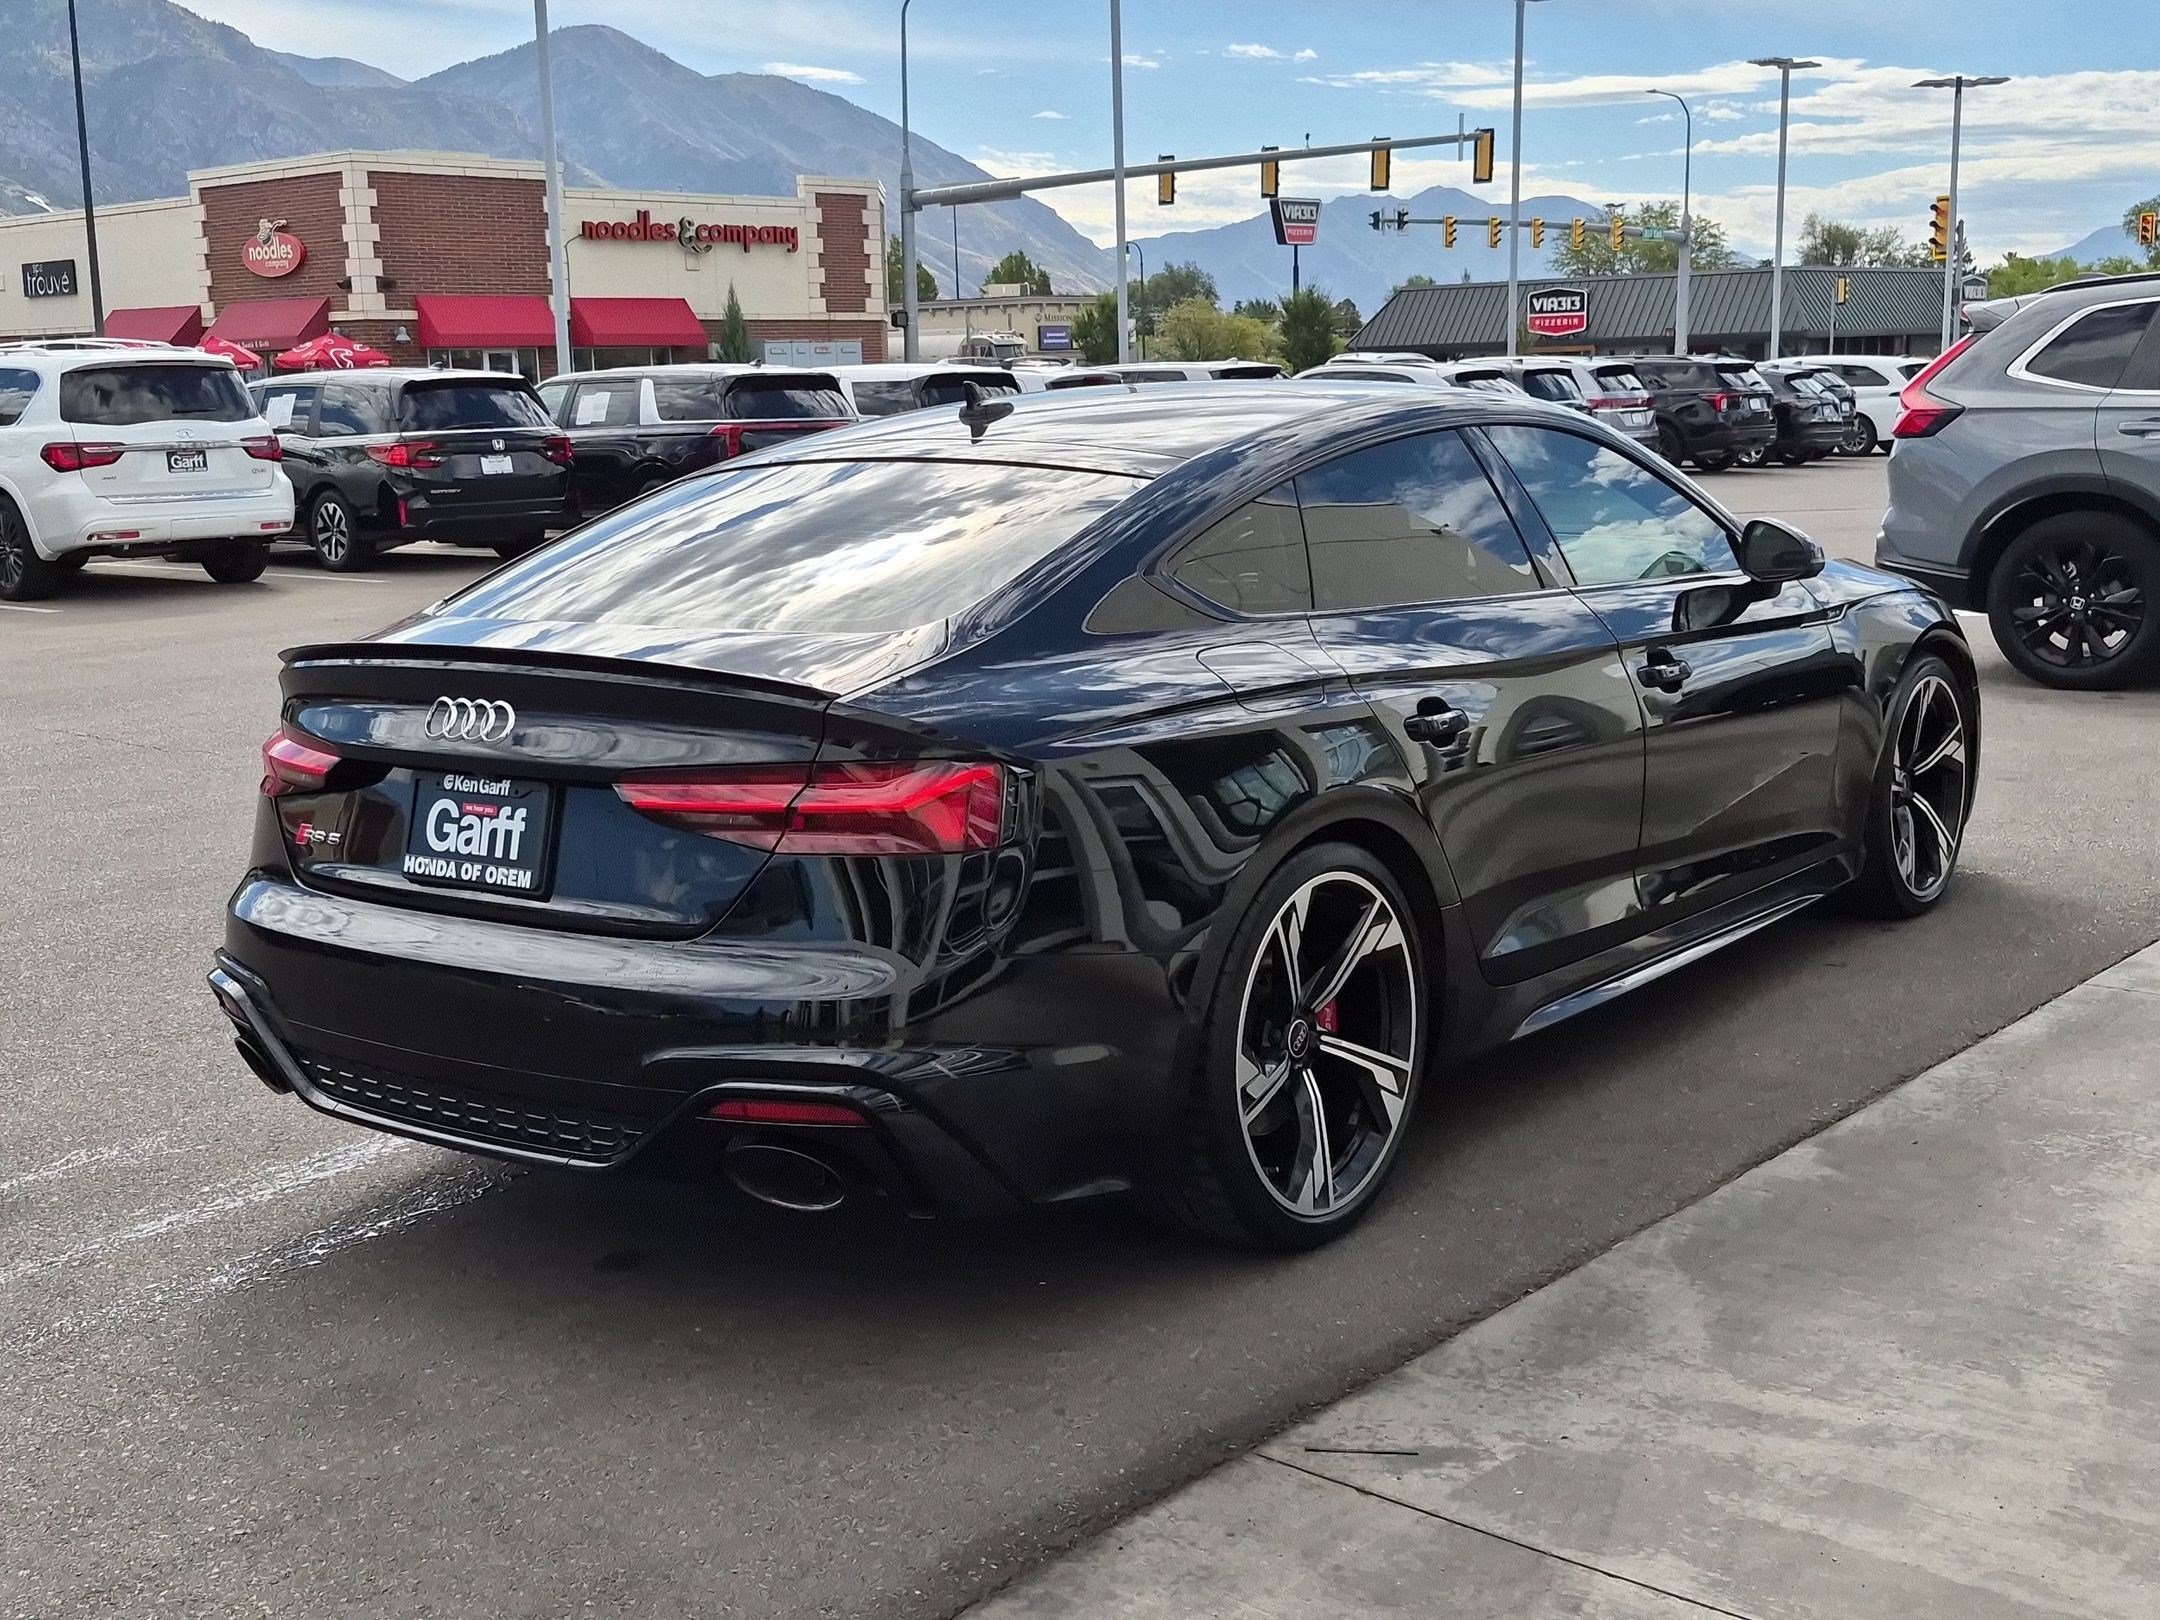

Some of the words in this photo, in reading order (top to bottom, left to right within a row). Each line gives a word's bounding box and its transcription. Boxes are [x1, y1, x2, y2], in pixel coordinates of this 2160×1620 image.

[582, 210, 677, 242] noodles
[695, 224, 799, 254] company
[248, 235, 293, 261] noodles
[27, 271, 70, 296] trouvé
[1534, 318, 1579, 326] PIZZERIA
[170, 454, 204, 469] Garff
[454, 775, 478, 793] Ken
[479, 779, 511, 796] Garff
[426, 798, 527, 861] Garff
[403, 854, 457, 879] HONDA
[460, 862, 482, 882] OF
[485, 866, 532, 889] OREM
